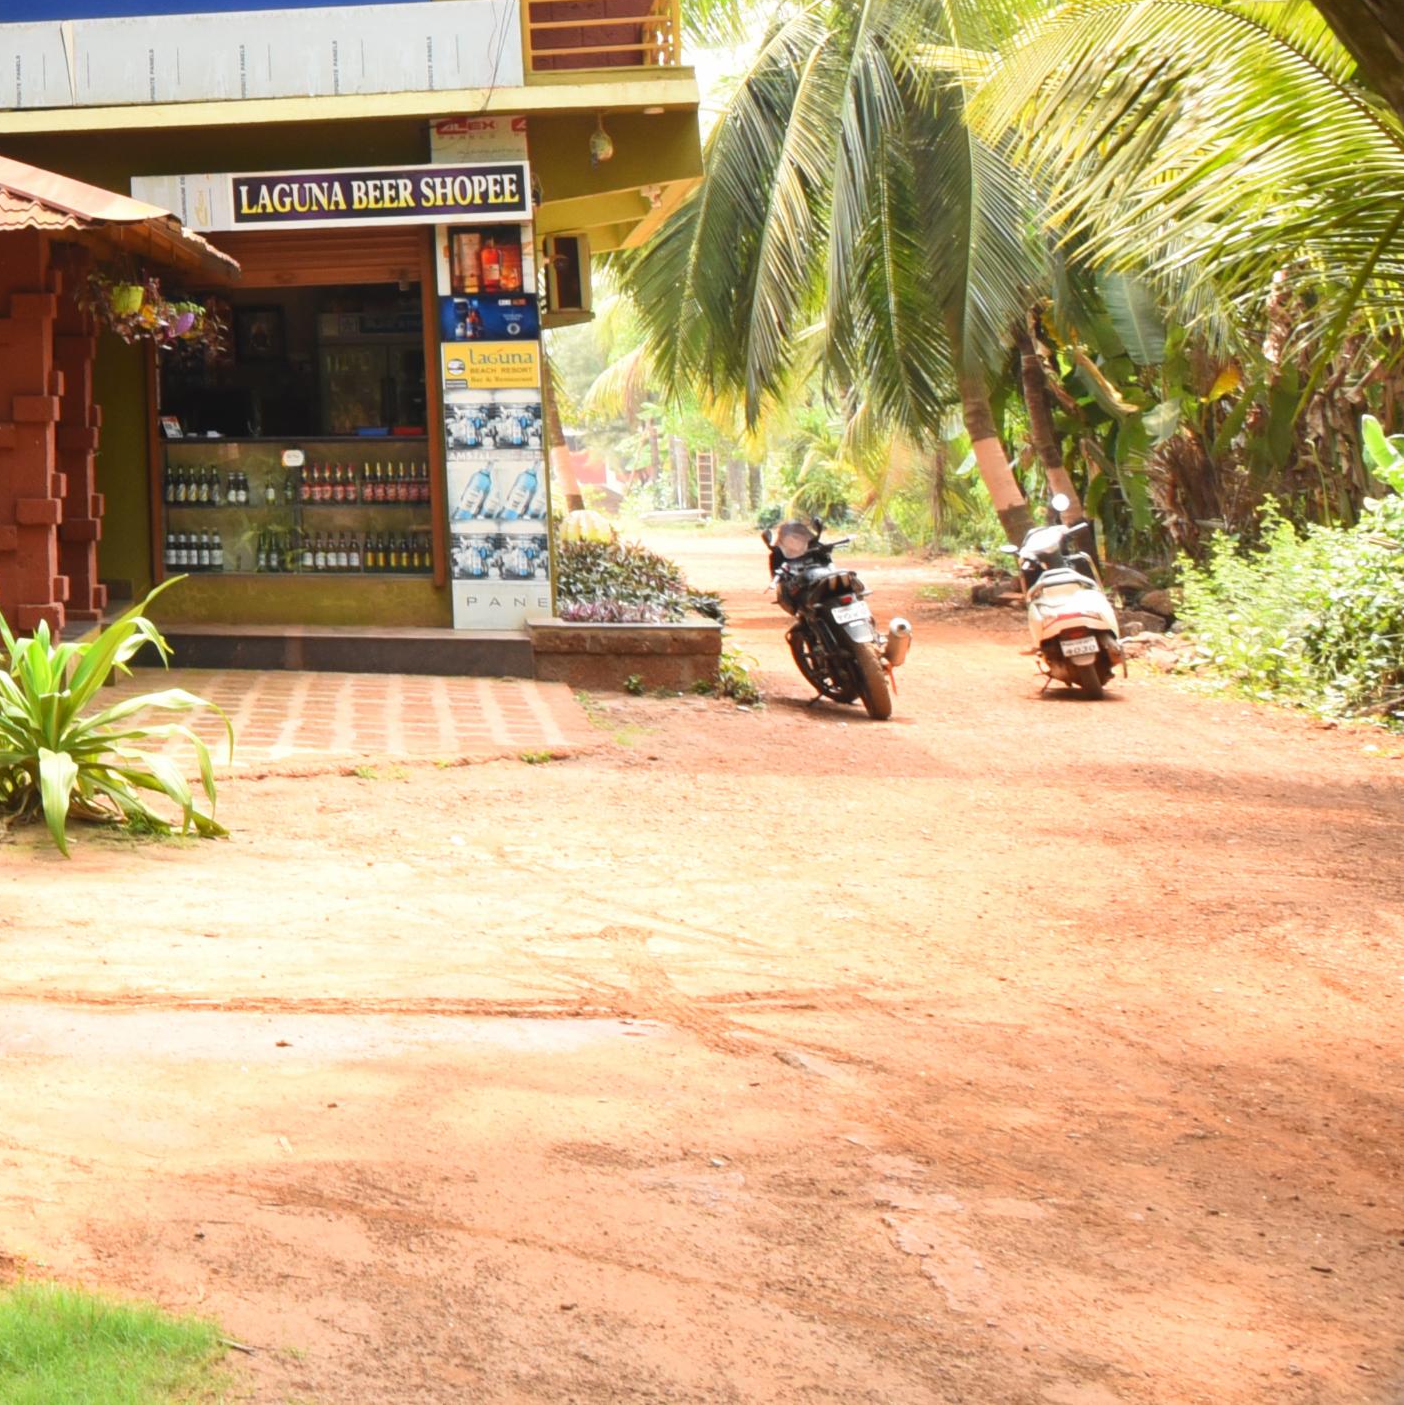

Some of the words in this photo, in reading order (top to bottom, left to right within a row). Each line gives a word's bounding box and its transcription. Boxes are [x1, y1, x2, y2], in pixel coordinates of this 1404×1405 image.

[239, 181, 347, 215] LAGUNA
[351, 176, 416, 210] BEER
[419, 173, 520, 208] SHOPEE
